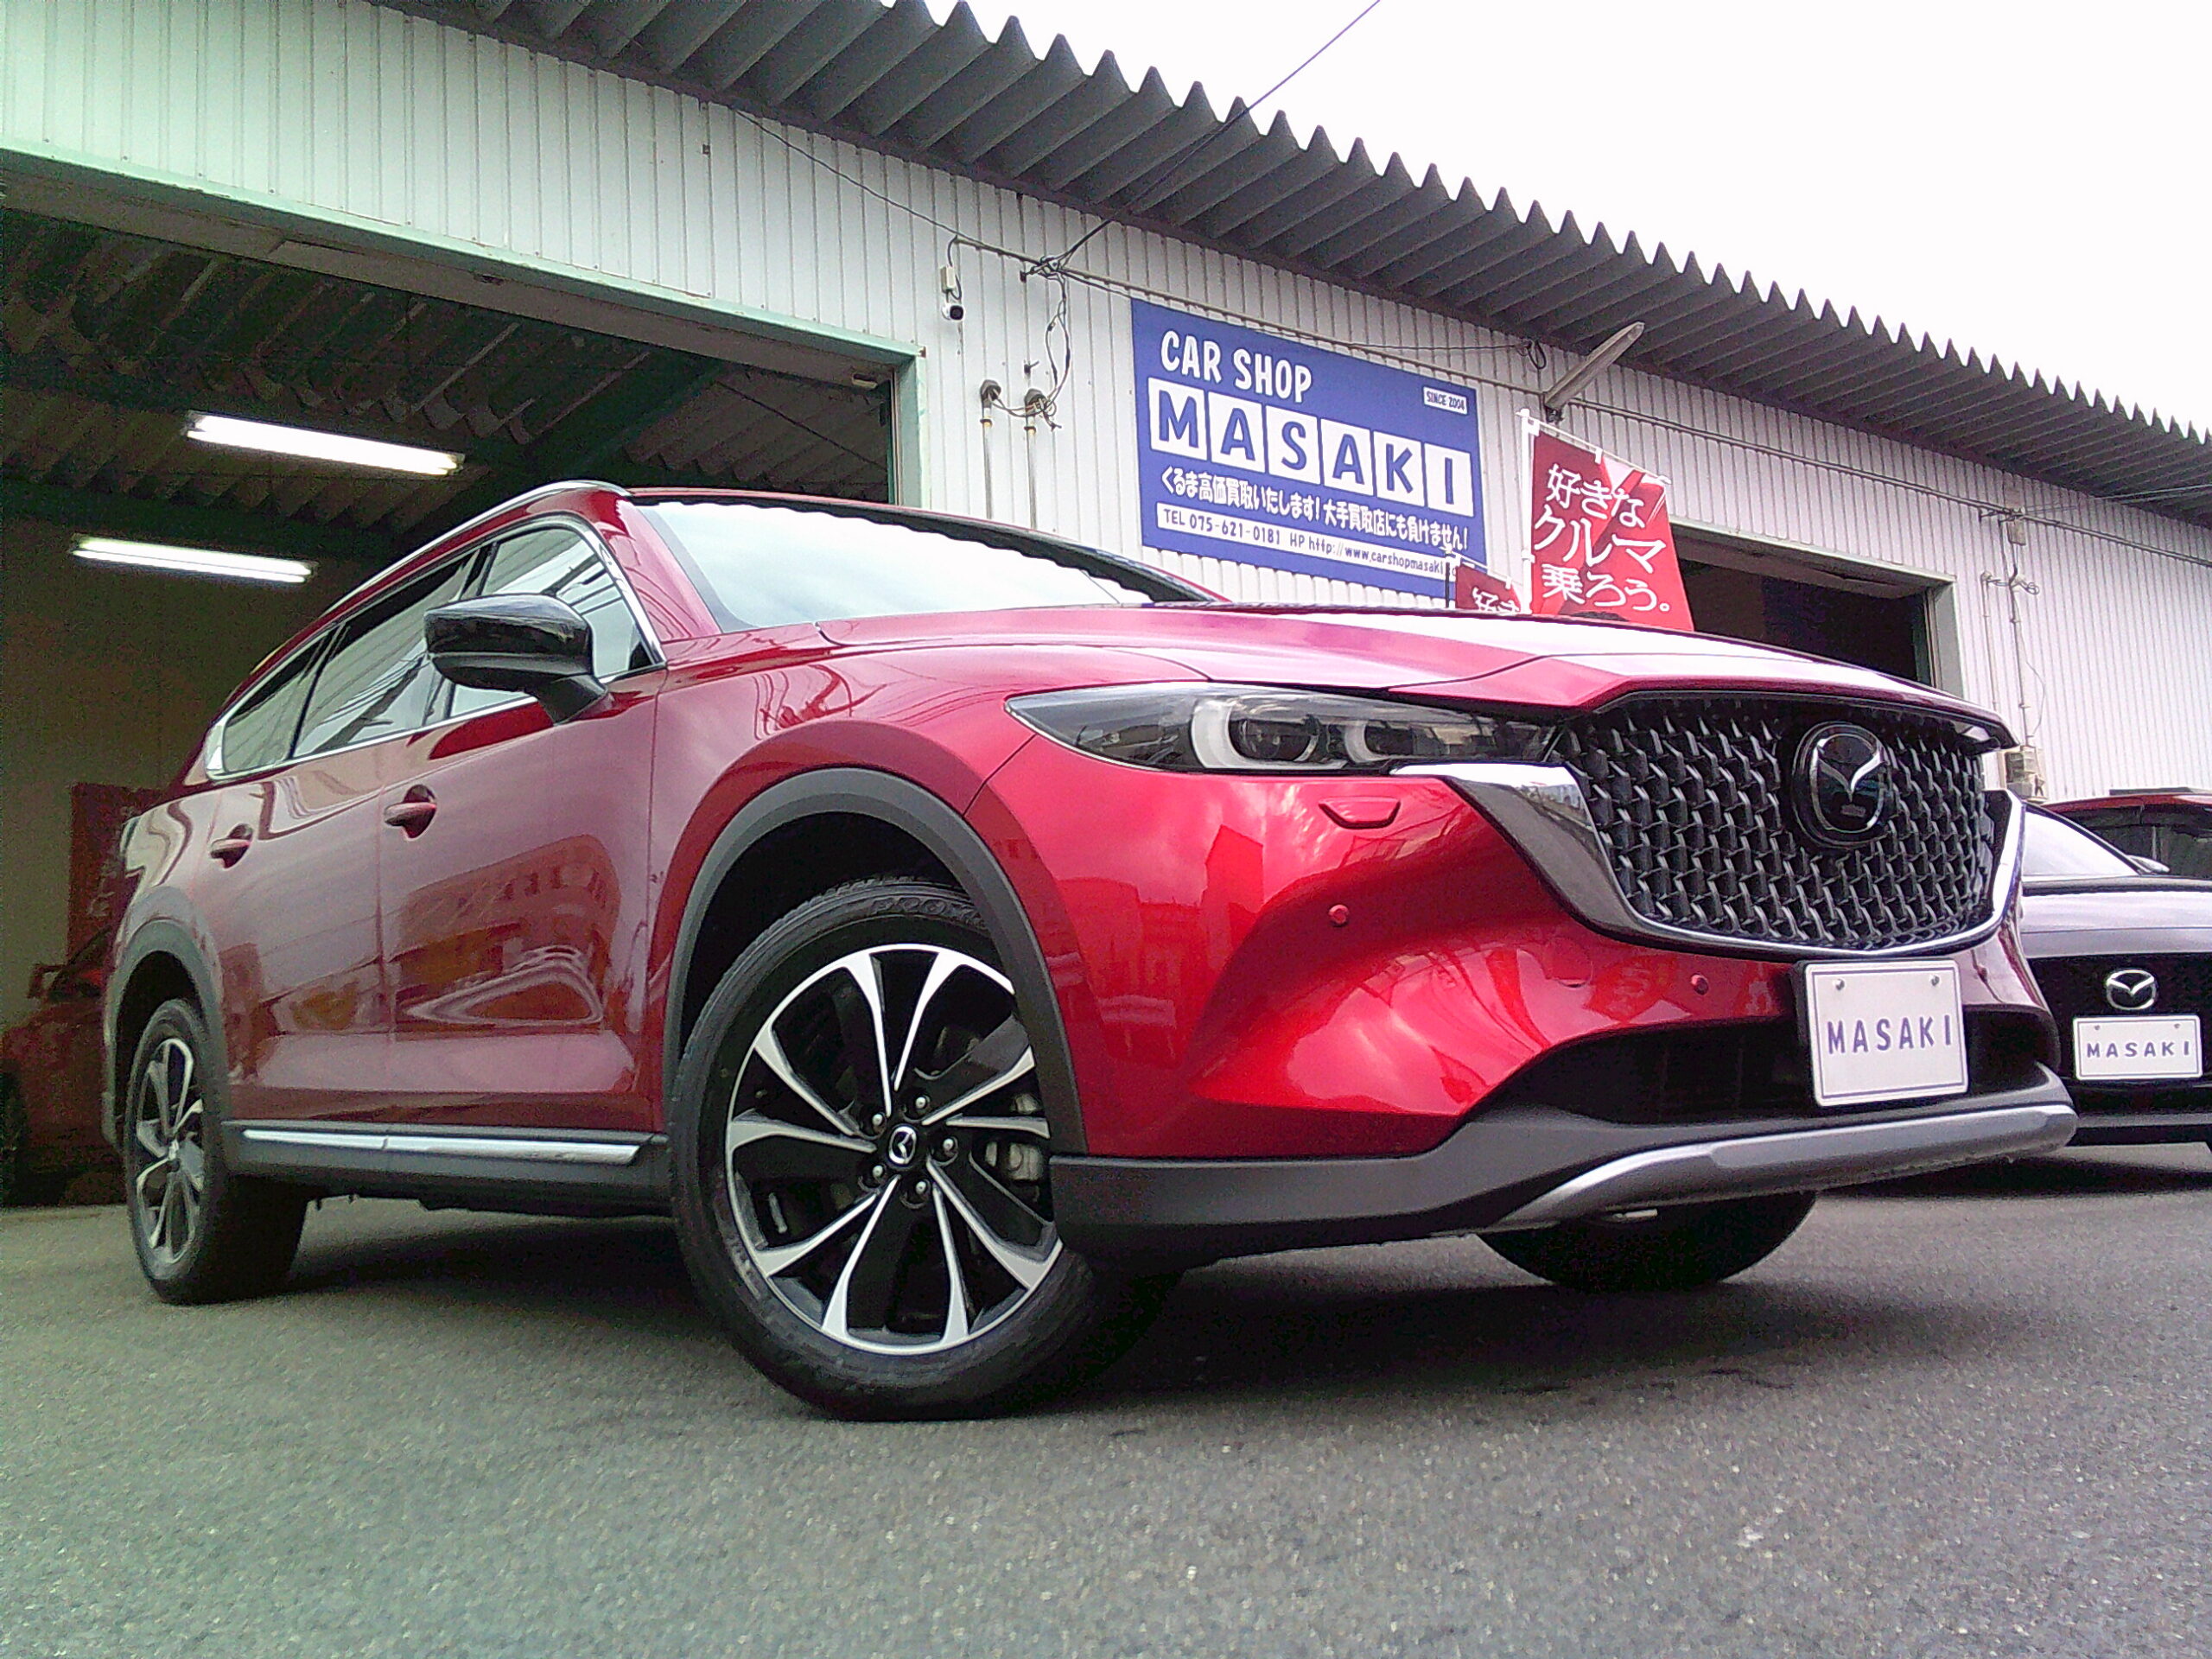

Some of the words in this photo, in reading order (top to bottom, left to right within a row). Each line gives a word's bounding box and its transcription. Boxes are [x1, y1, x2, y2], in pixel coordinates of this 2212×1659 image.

[1160, 330, 1222, 385] CAR
[1232, 348, 1313, 404] SHOP
[1426, 391, 1447, 406] SINCE
[1448, 396, 1465, 411] 2004
[1158, 389, 1452, 505] MASAKI
[1547, 463, 1645, 529] 好きな
[1164, 508, 1185, 526] TEL
[1189, 513, 1281, 545] 075-621-0181
[1290, 533, 1305, 548] HP
[1534, 504, 1666, 574] クルマ
[1541, 563, 1670, 612] 乗ろう。
[1827, 1014, 1953, 1054] MASAKI
[2087, 1040, 2190, 1059] MASAKI
